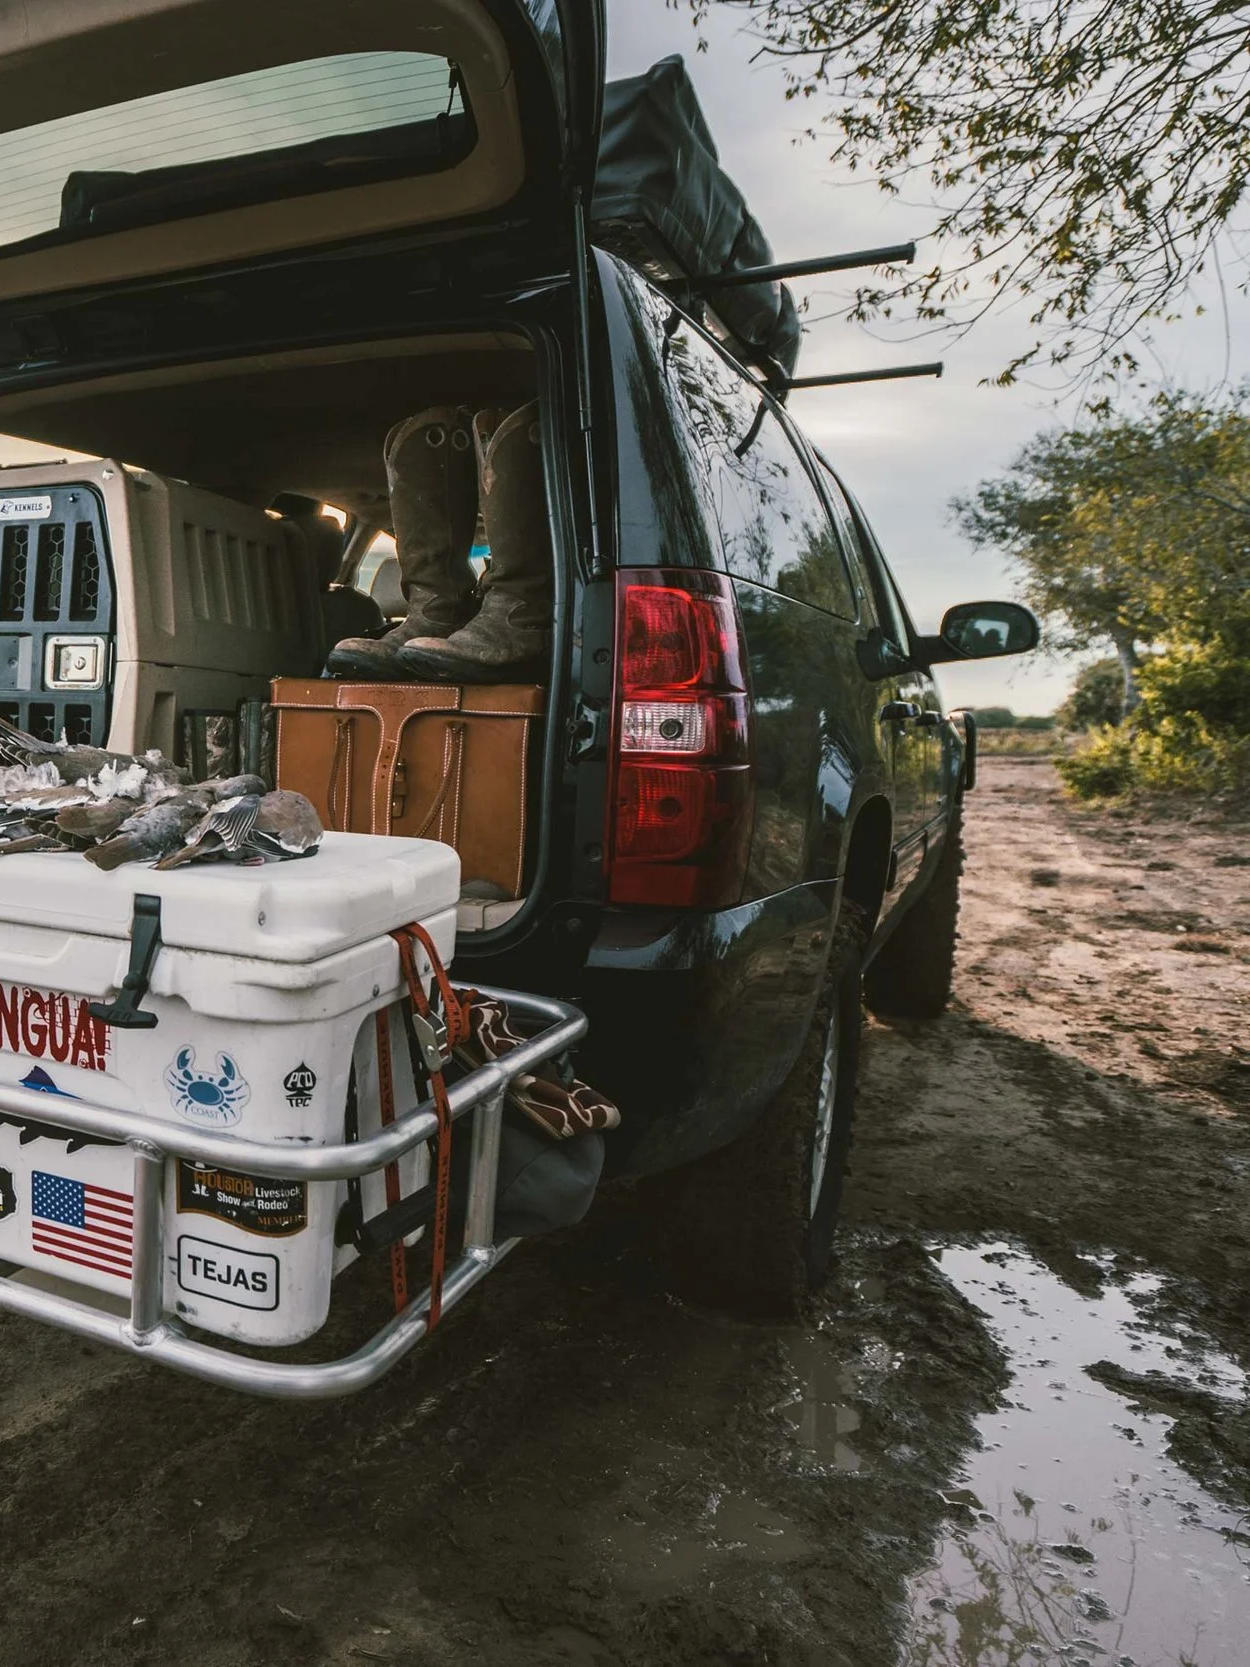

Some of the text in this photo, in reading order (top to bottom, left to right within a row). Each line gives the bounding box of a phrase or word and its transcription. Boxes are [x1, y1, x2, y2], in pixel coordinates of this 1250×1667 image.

[14, 503, 43, 511] KENNELS
[191, 1105, 219, 1119] COAST
[255, 1186, 301, 1199] Livestock
[216, 1191, 242, 1206] Show
[257, 1199, 288, 1210] Rodeo
[187, 1254, 268, 1293] TEJAS
